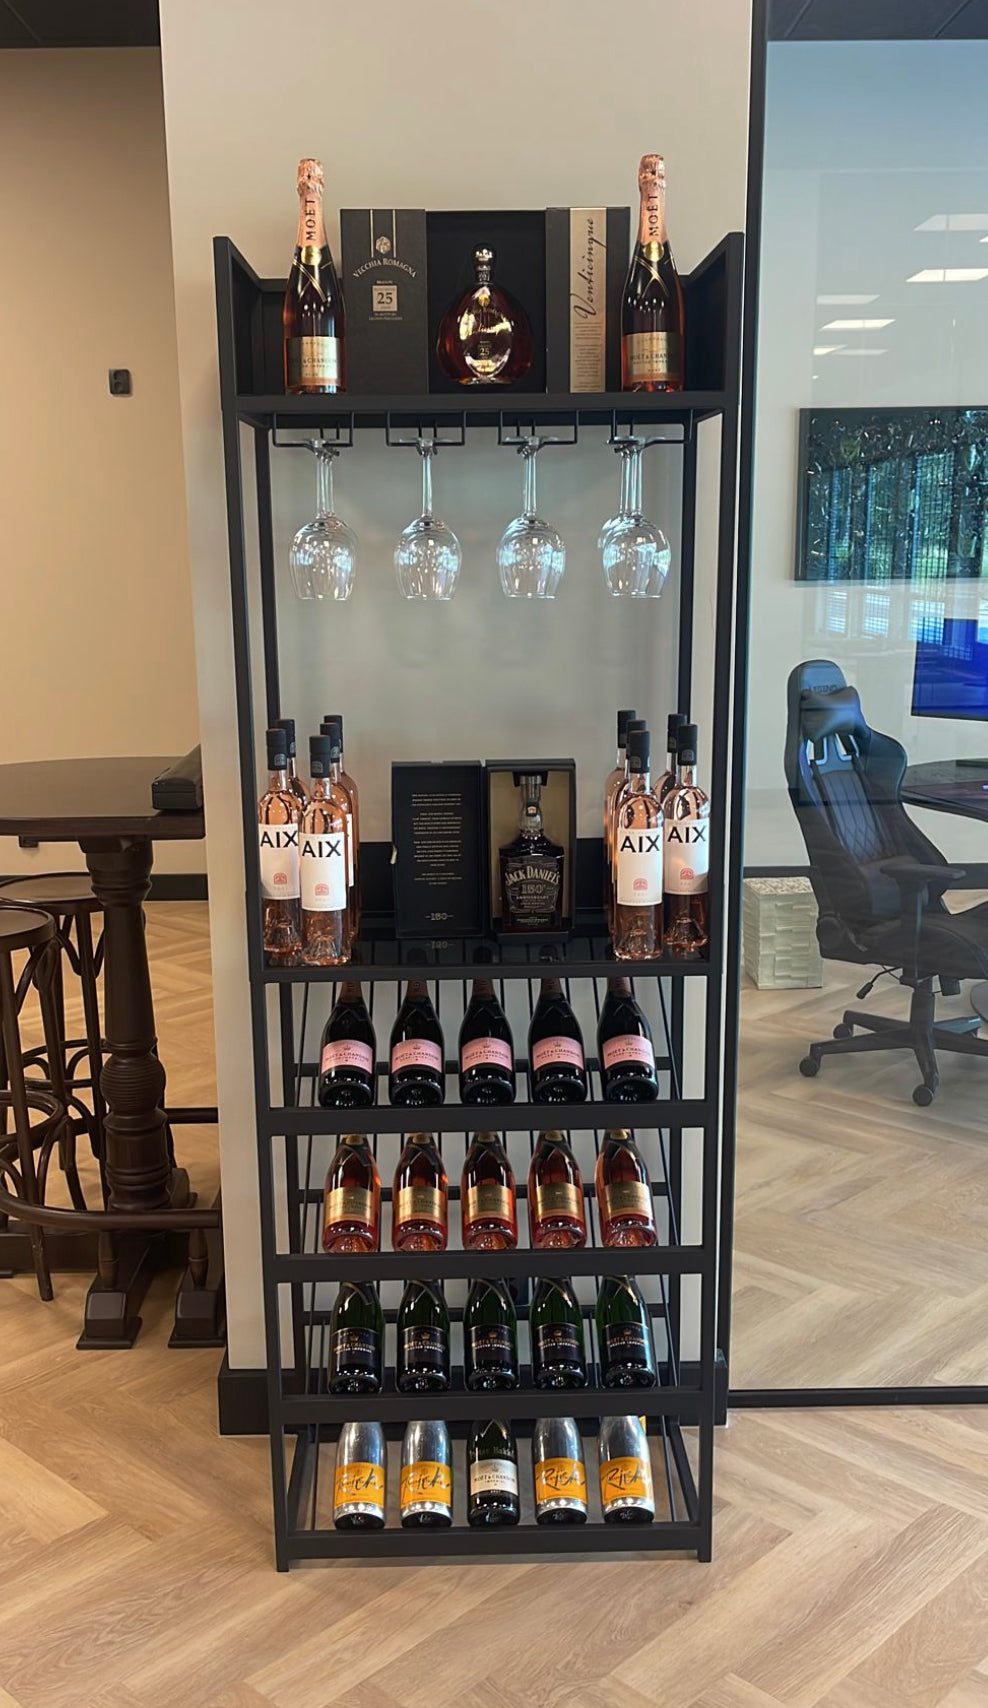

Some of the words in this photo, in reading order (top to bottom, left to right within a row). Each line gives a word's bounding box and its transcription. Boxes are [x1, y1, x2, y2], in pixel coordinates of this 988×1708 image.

[352, 259, 382, 278] VECCHIA
[382, 257, 417, 278] ROMAGNA
[377, 292, 393, 304] 25
[260, 830, 299, 849] AIX
[620, 835, 661, 853] AIX
[666, 825, 706, 844] AIX
[301, 840, 342, 858] AIX
[505, 869, 526, 886] JACK
[526, 865, 560, 886] DANIEL'S
